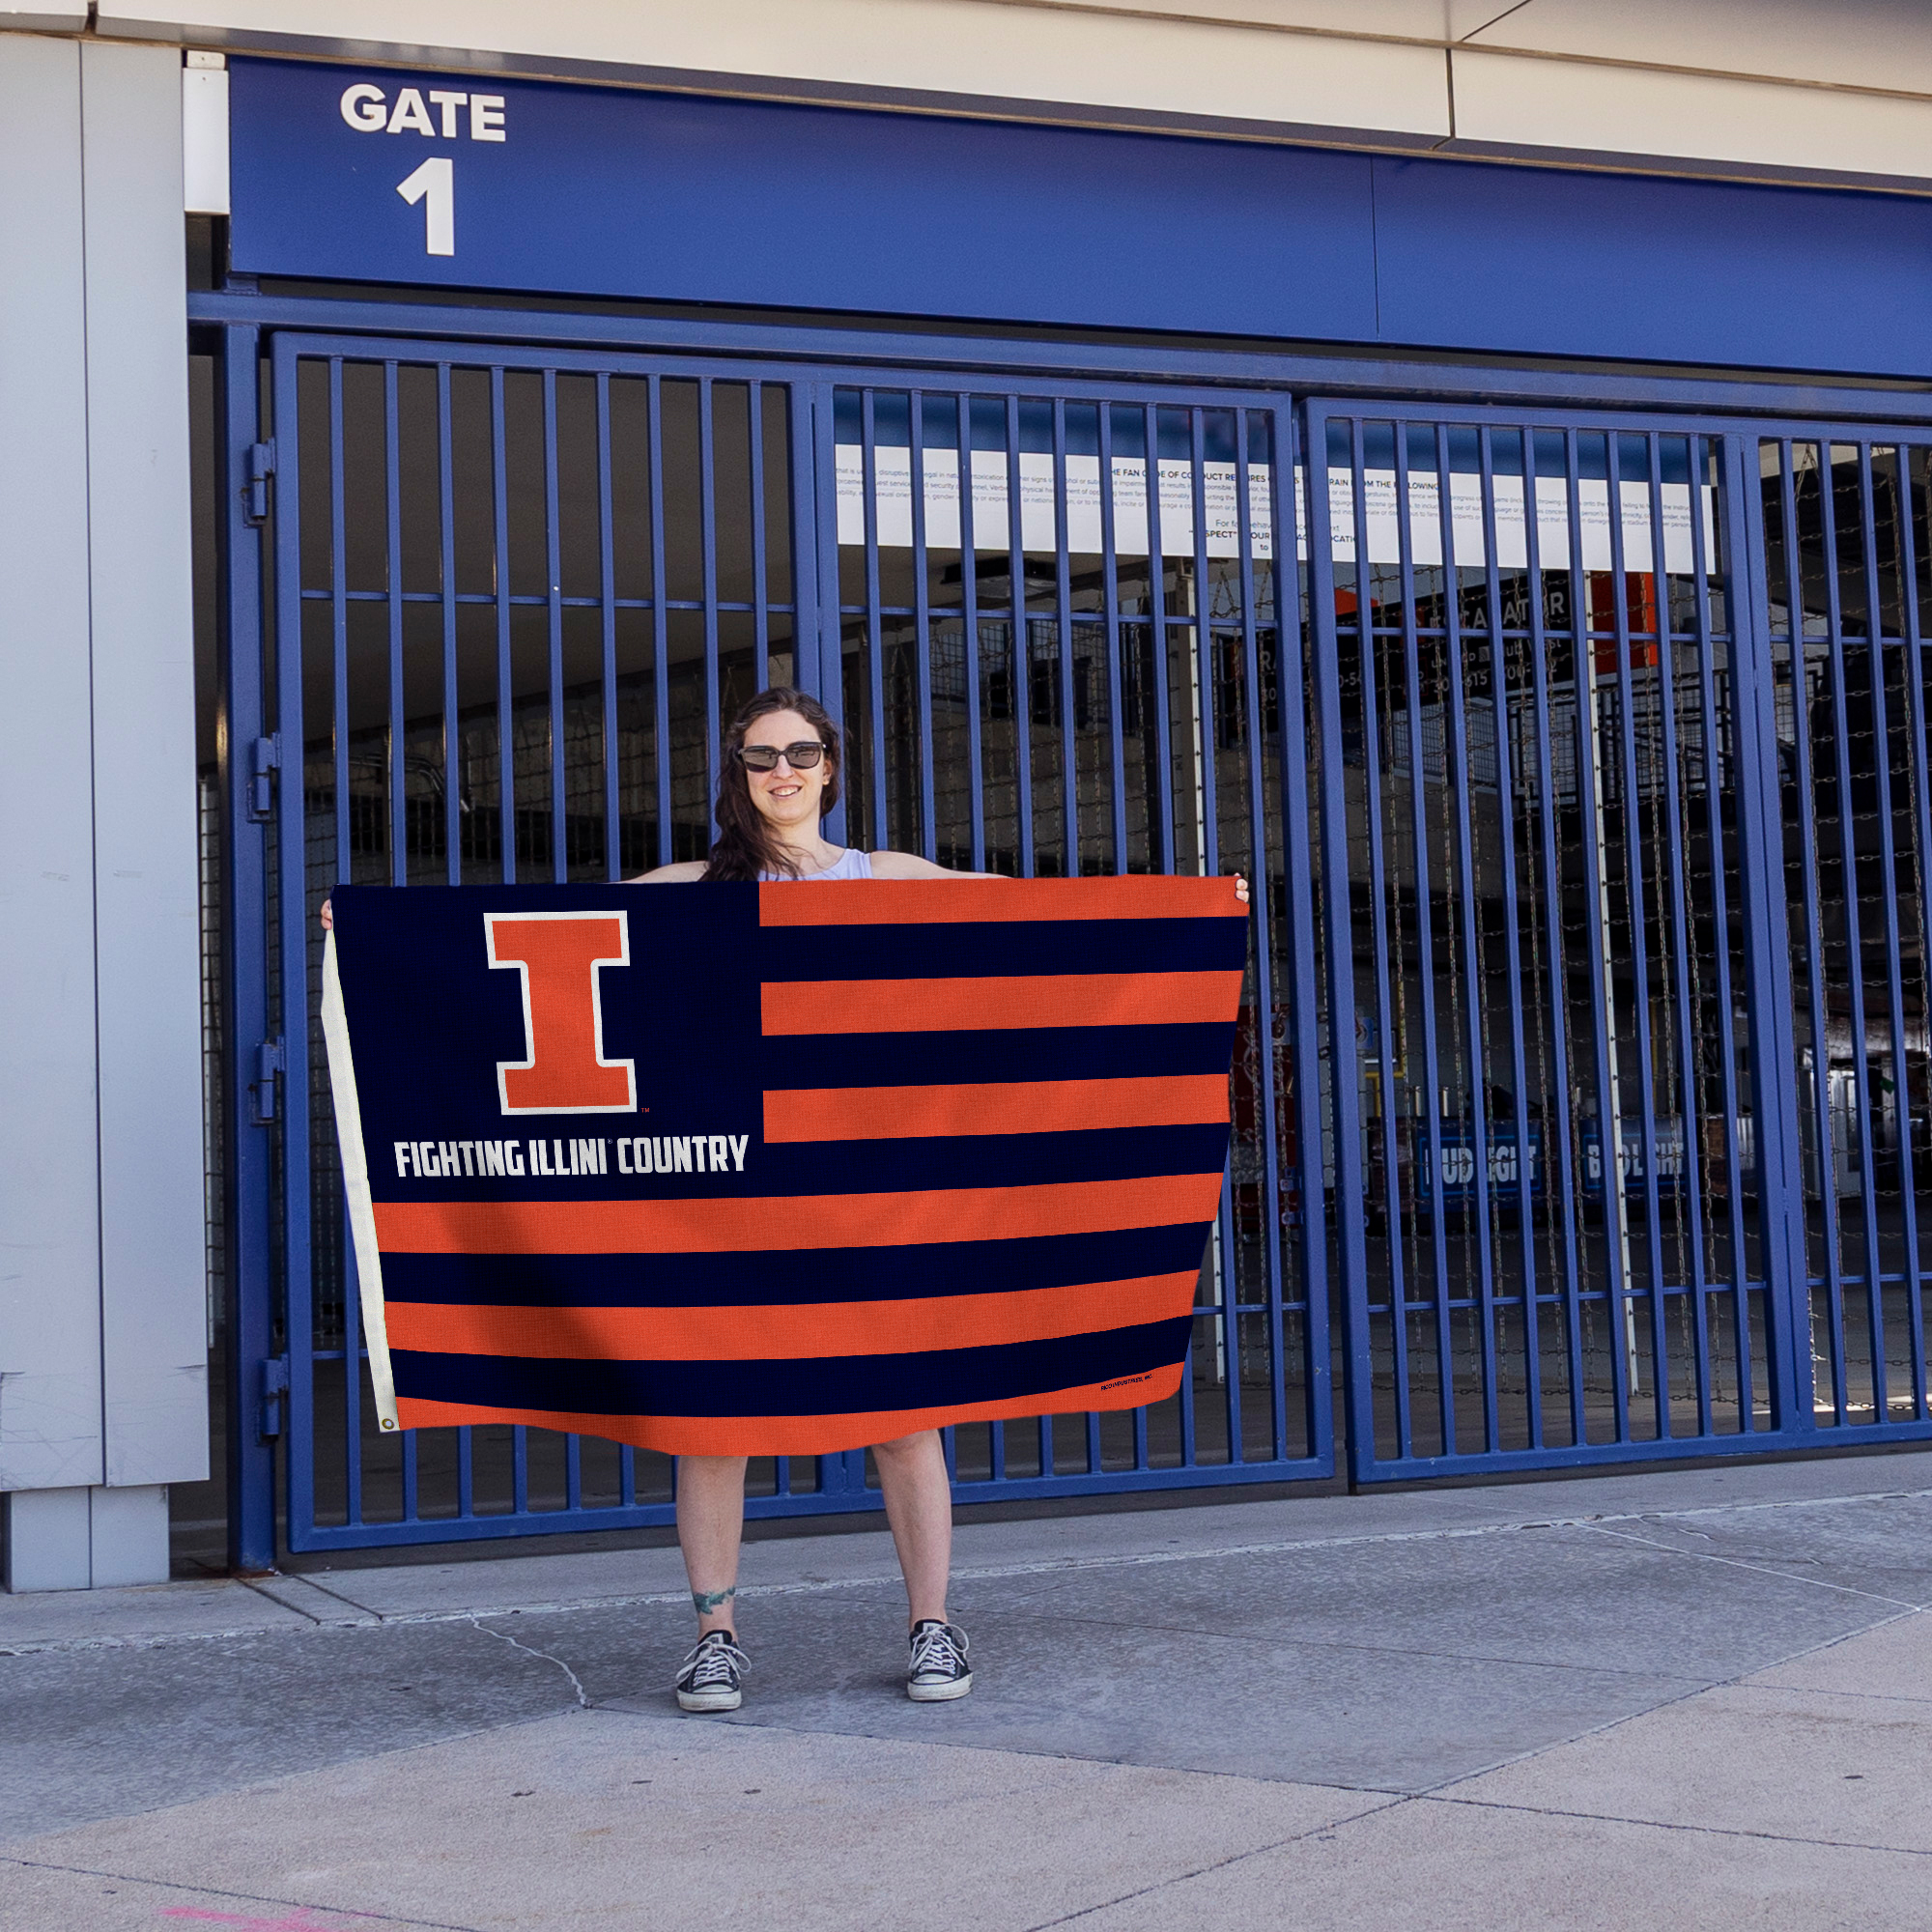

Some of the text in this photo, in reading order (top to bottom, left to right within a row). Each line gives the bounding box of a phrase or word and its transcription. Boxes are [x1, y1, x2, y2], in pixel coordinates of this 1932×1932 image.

[340, 83, 506, 142] GATE
[396, 156, 454, 256] 1
[1123, 469, 1140, 478] FAN
[1168, 470, 1179, 479] OF
[1376, 480, 1391, 489] THE
[1215, 519, 1230, 527] For
[484, 910, 638, 1116] I
[394, 1141, 524, 1178] FIGHTING
[617, 1135, 749, 1174] COUNTRY
